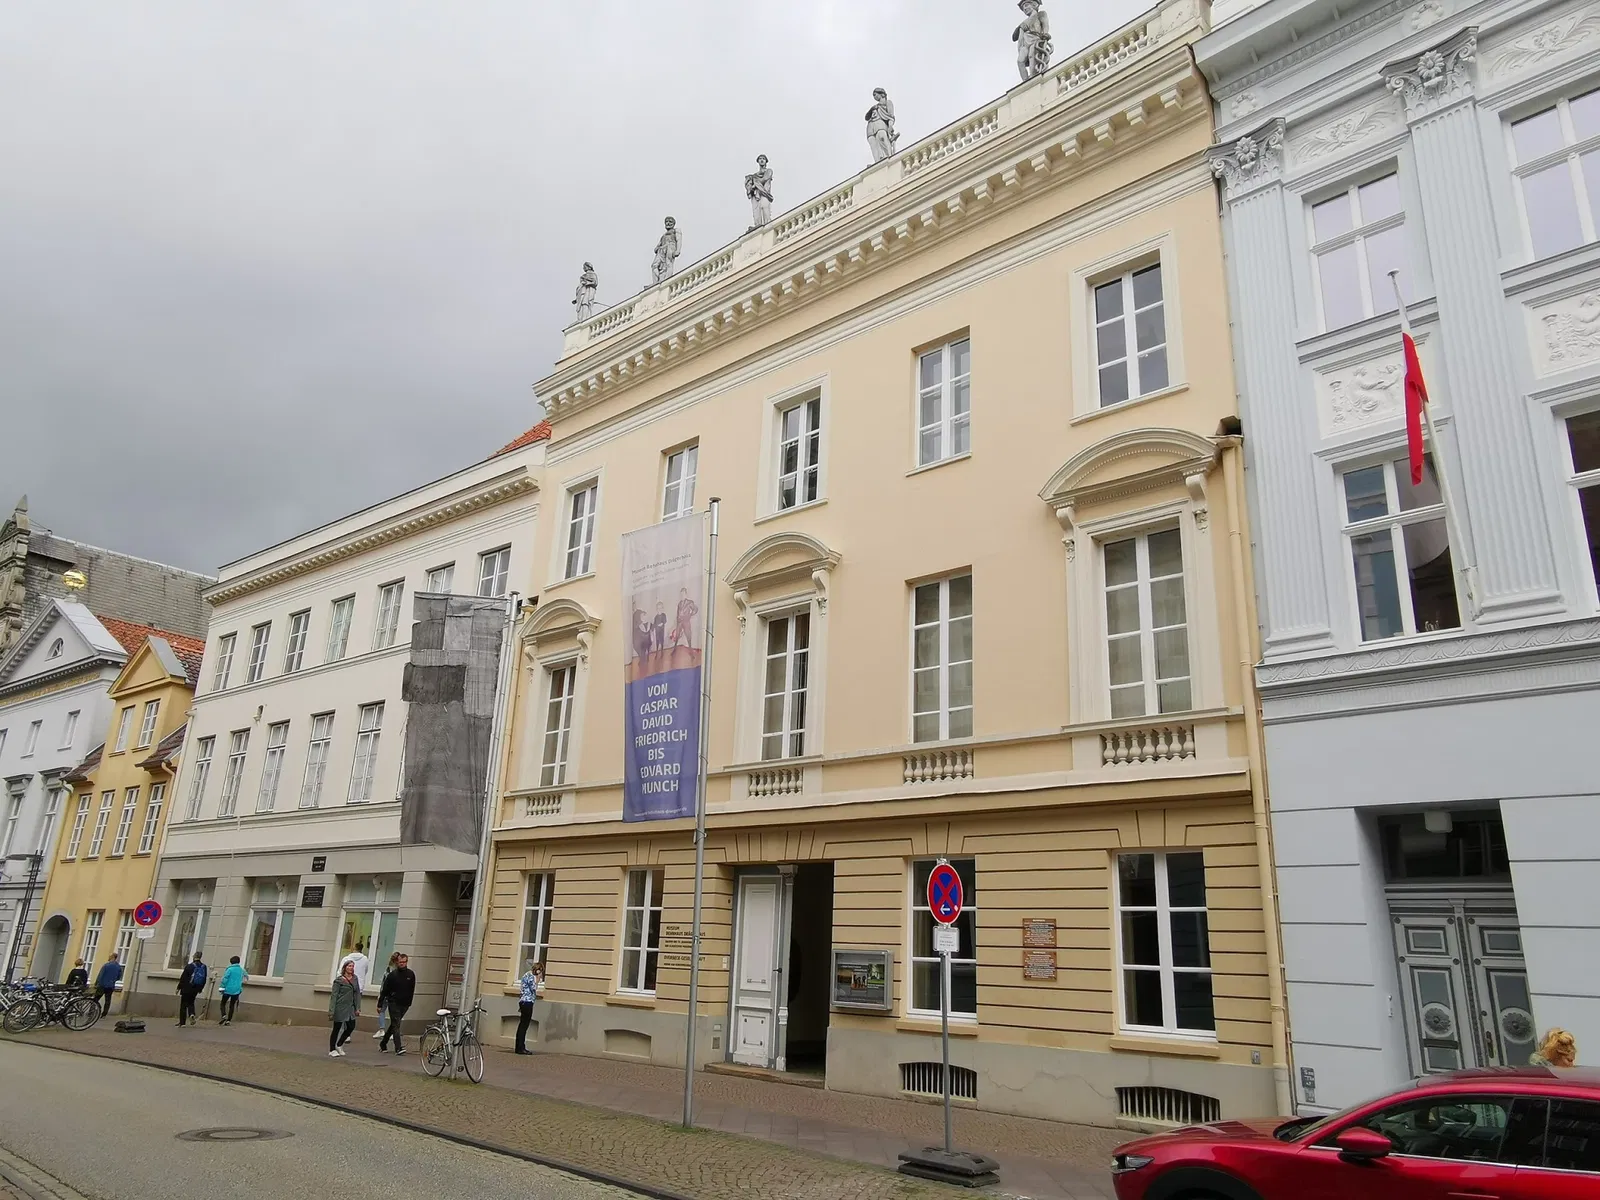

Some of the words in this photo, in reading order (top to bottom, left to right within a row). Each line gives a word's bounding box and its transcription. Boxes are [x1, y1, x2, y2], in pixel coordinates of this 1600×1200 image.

[647, 683, 668, 698] VON
[640, 697, 678, 715] CASPAR
[642, 714, 673, 730] DAVID
[635, 729, 688, 748] FRIEDRICH
[648, 747, 665, 761] BIS
[640, 763, 681, 779] EDVARD
[642, 780, 679, 795] MUNCH
